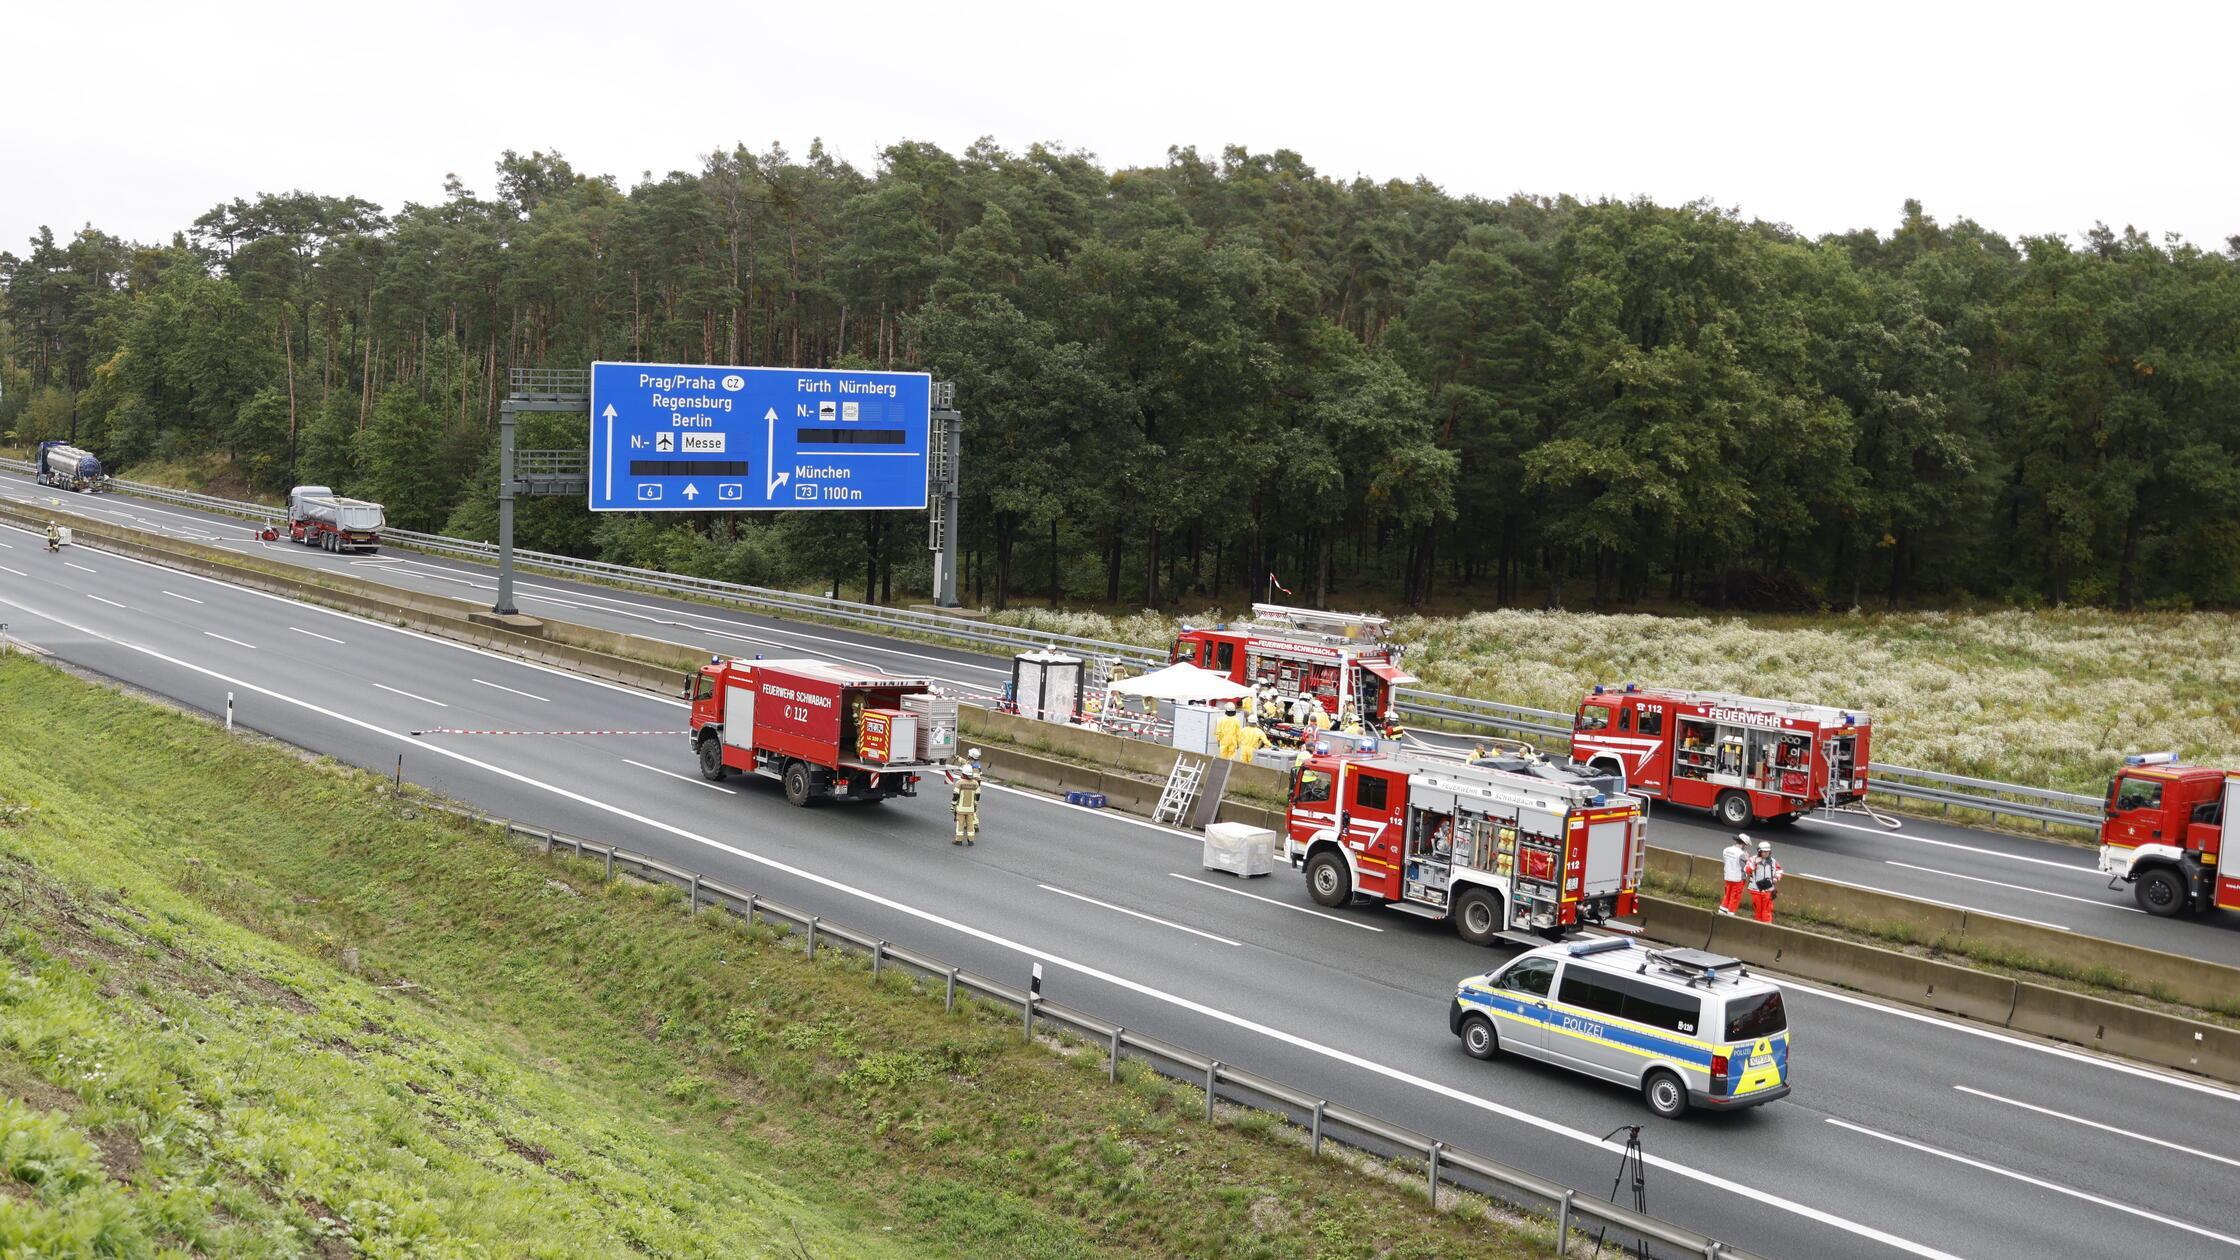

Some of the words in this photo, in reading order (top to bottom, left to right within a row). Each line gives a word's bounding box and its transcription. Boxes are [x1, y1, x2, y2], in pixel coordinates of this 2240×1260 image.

[639, 374, 716, 391] Prag/Praha
[727, 378, 739, 388] CZ
[797, 378, 831, 393] Fürth
[839, 380, 897, 398] Nürnberg
[652, 393, 732, 412] Regensburg
[672, 413, 712, 427] Berlin
[685, 437, 721, 449] Messe
[795, 465, 851, 479] München
[646, 487, 653, 497] 6
[727, 487, 734, 497] 6
[801, 487, 812, 497] 73
[823, 486, 849, 500] 1100
[850, 489, 862, 500] m
[762, 683, 795, 701] FEUERWEHR
[796, 691, 832, 709] SCHWABACH
[793, 706, 808, 723] 112
[1647, 704, 1663, 713] 112
[1708, 708, 1781, 728] FEUERWEHR
[1389, 816, 1403, 826] 112
[1566, 860, 1580, 870] 112
[1563, 1017, 1604, 1038] POLIZEI
